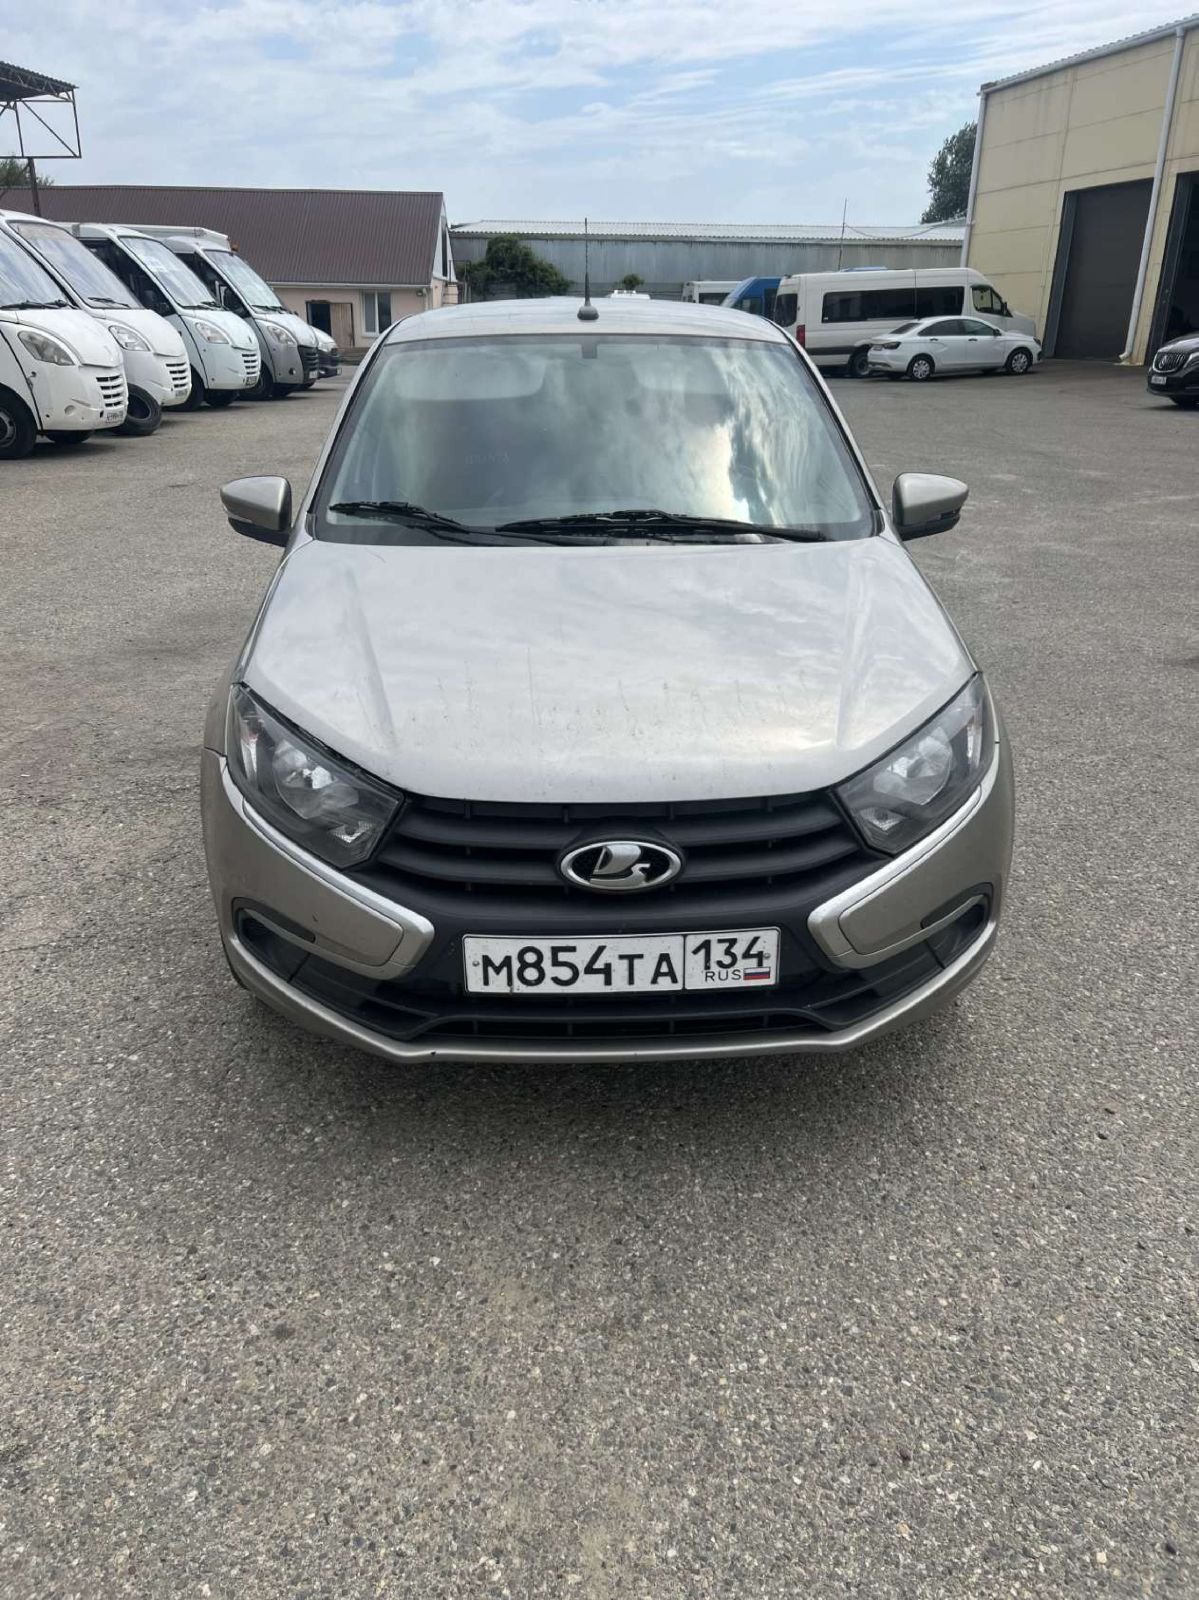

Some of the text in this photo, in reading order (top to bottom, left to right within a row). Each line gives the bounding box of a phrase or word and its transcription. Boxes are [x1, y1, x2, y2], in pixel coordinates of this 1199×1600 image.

[482, 936, 764, 987] М854ТА 134
[705, 969, 742, 982] RUS
